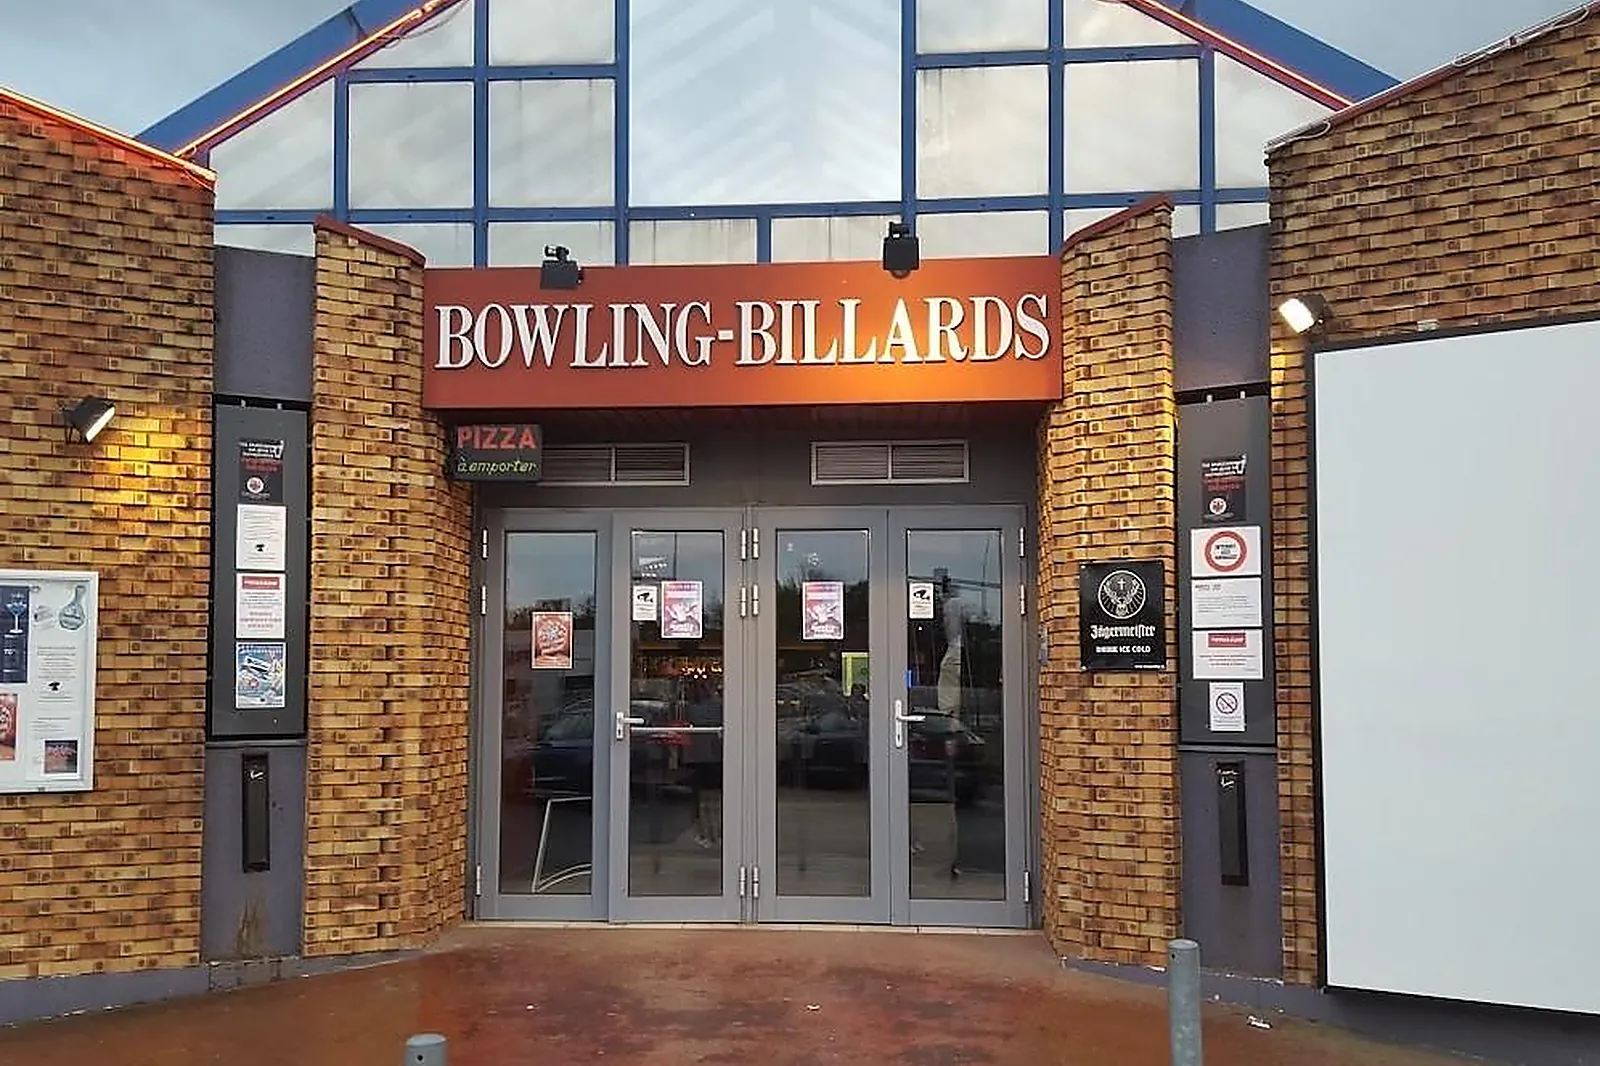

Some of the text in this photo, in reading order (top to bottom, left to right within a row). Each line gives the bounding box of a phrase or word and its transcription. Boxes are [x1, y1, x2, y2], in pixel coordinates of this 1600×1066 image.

[434, 293, 1050, 370] BOWLING-BILLARDS
[457, 427, 537, 449] PIZZA
[468, 458, 538, 475] emporter
[1131, 645, 1151, 653] COLD
